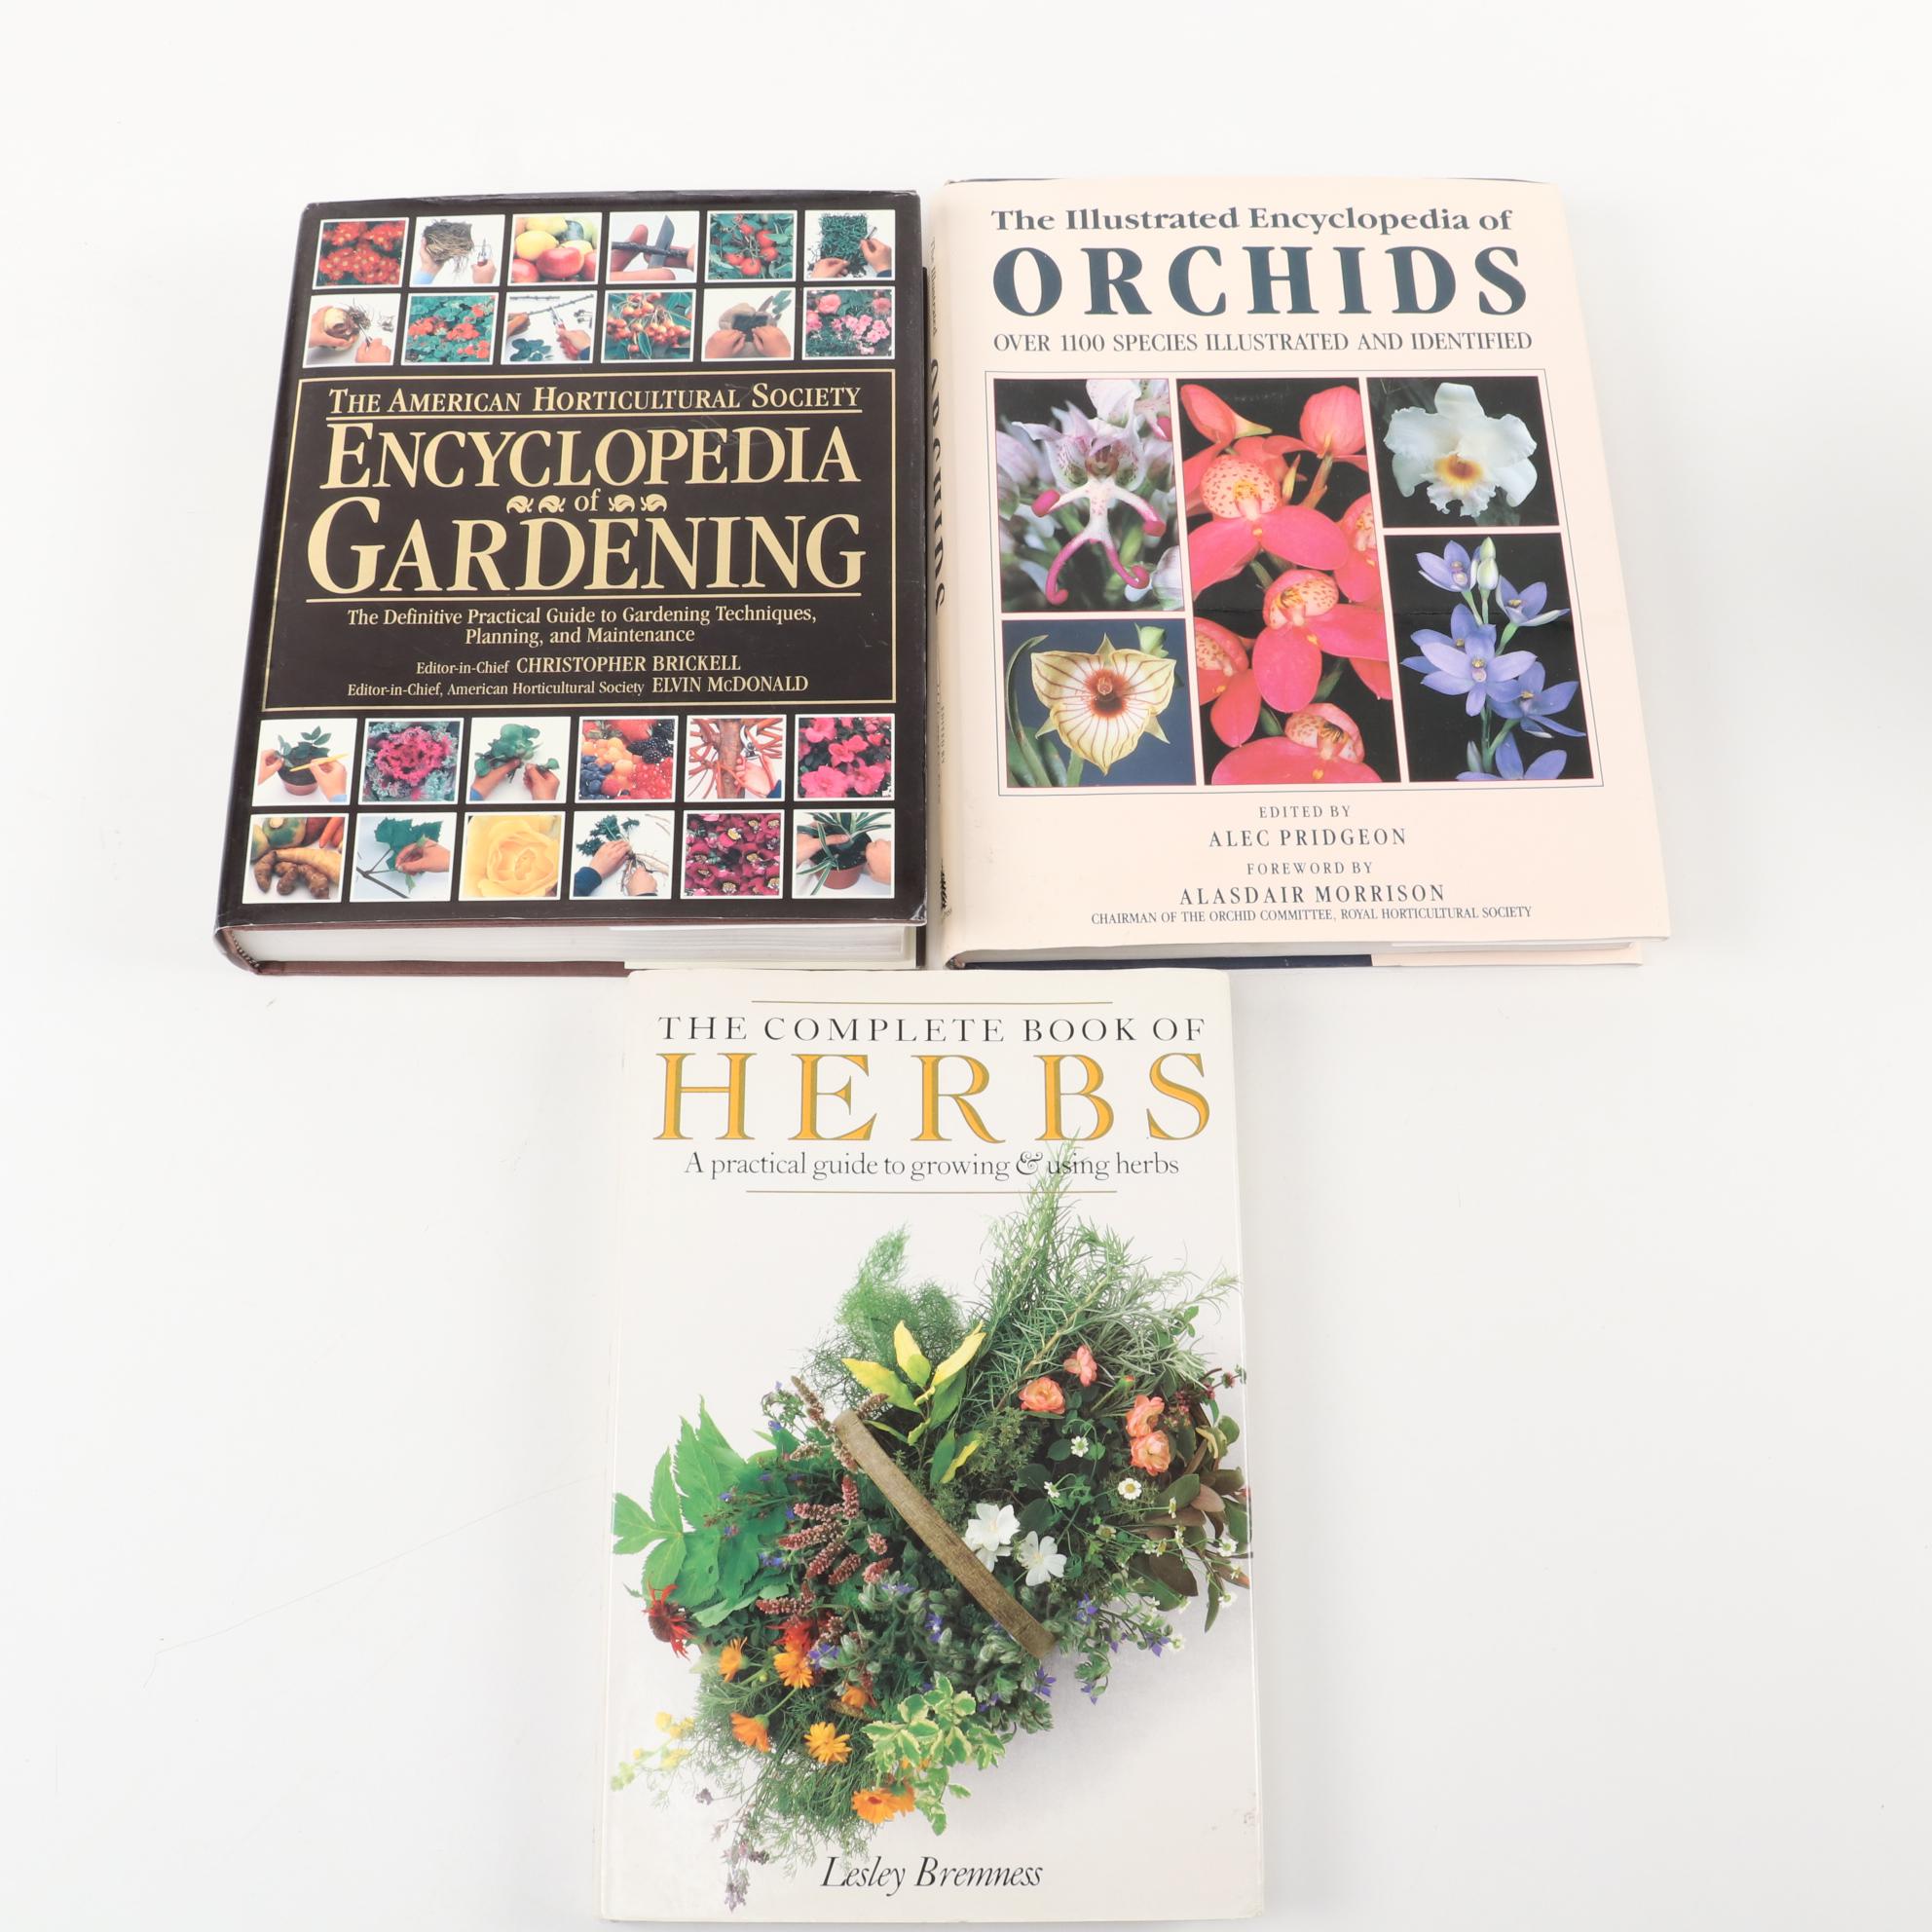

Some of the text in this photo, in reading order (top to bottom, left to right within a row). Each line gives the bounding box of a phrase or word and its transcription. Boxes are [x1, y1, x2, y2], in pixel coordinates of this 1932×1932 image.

[990, 206, 1513, 235] The Illustrated Encyclopedia of
[992, 245, 1527, 317] ORCHIDS
[992, 331, 1534, 353] OVER 1100 SPECIES ILLUSTRATED AND IDENTIFIED
[328, 384, 861, 414] THE AMERICAN HORTICULTURAL SOCIETY
[319, 423, 862, 490] ENCYCLOPEDIA
[574, 490, 599, 511] of
[307, 497, 867, 593] GARDENING
[348, 605, 817, 626] The Definitive Practical Guide to Gardening Techniques,
[464, 627, 696, 648] Planning, and Maintenance
[416, 655, 741, 675] Editor-in-Chief CHRISTOPHER BRICKELL
[347, 676, 809, 698] Editor-in-Chief, American Horticultural Society ELVIN McDONALD
[1258, 805, 1352, 819] EDITED BY
[1208, 828, 1407, 847] ALEC PRIDGEON
[1246, 862, 1373, 875] FOREWORD BY
[1179, 884, 1446, 906] ALASDAIR MORRISON
[1091, 906, 1533, 925] CHAIRMAN OF THE ORCHID COMMITTEE, ROYAL HORTICULTURAL SOCIETY
[658, 1016, 1207, 1043] THE COMPLETE BOOK OF
[651, 1052, 1211, 1144] HERBS
[684, 1151, 1180, 1181] A practical guide to growing & using herbs
[819, 1855, 1044, 1897] Lesley Bremness
